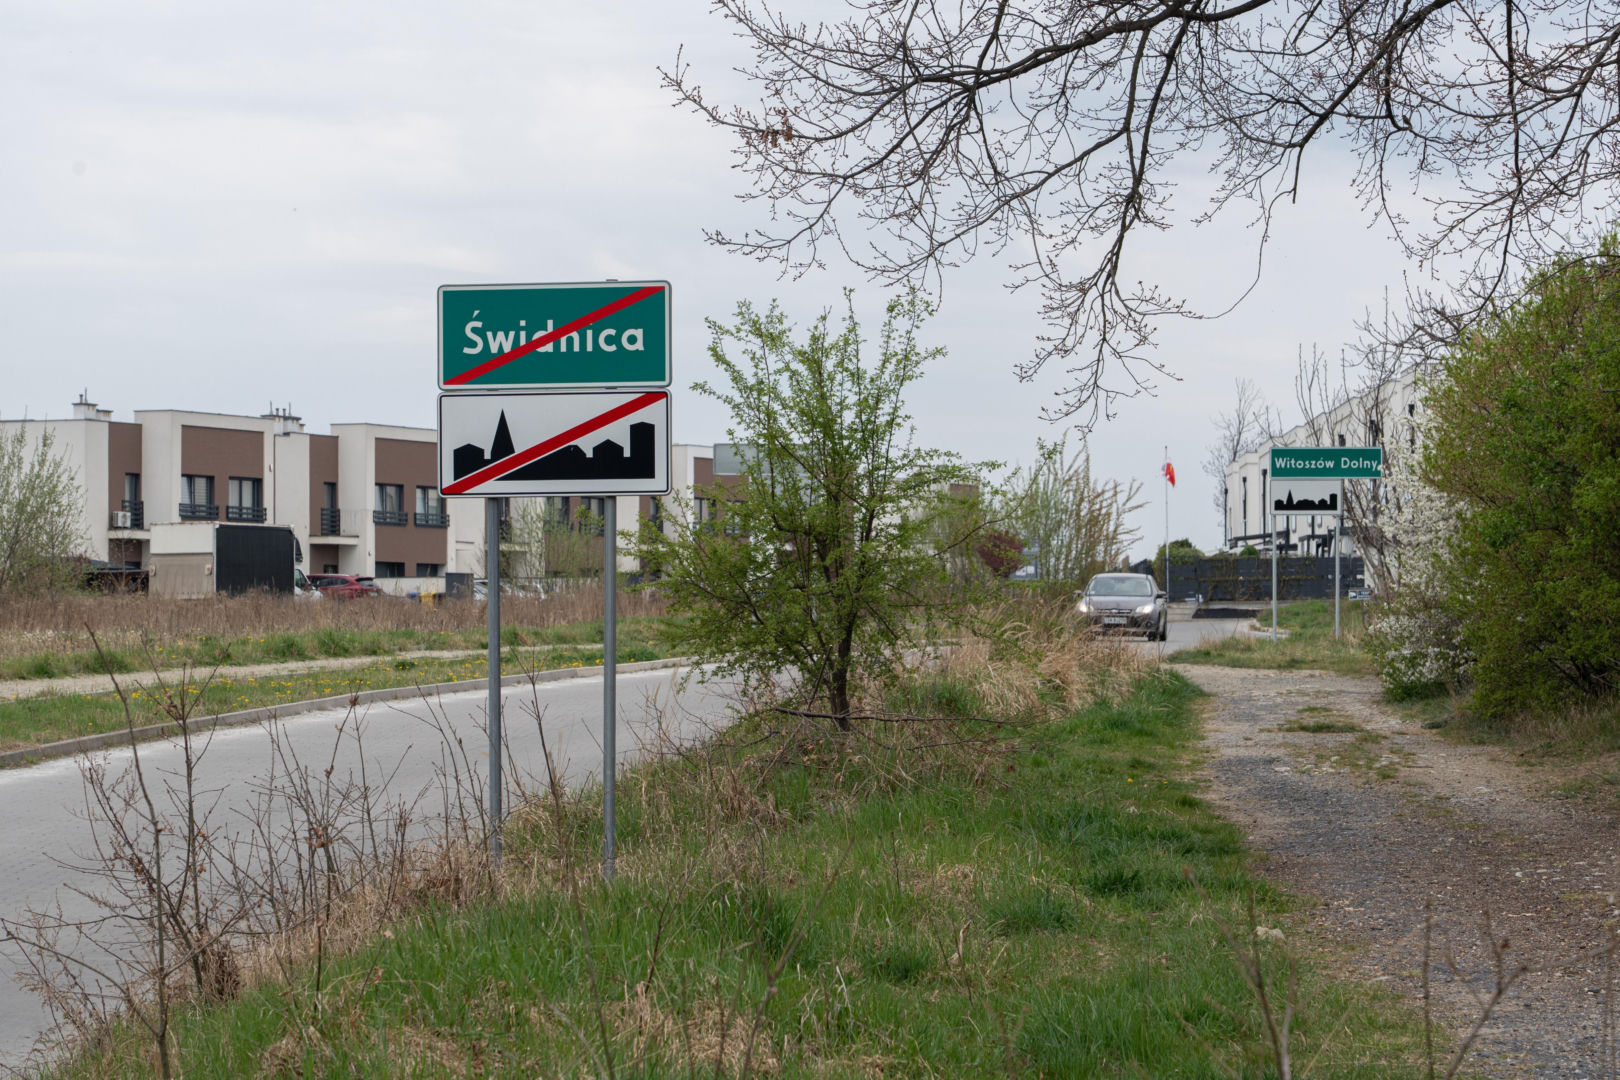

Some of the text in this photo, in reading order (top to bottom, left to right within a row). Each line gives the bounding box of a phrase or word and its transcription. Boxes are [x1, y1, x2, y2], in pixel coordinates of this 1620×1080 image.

[462, 310, 645, 354] Świdnica
[1274, 456, 1378, 472] Witoszów Dolny
